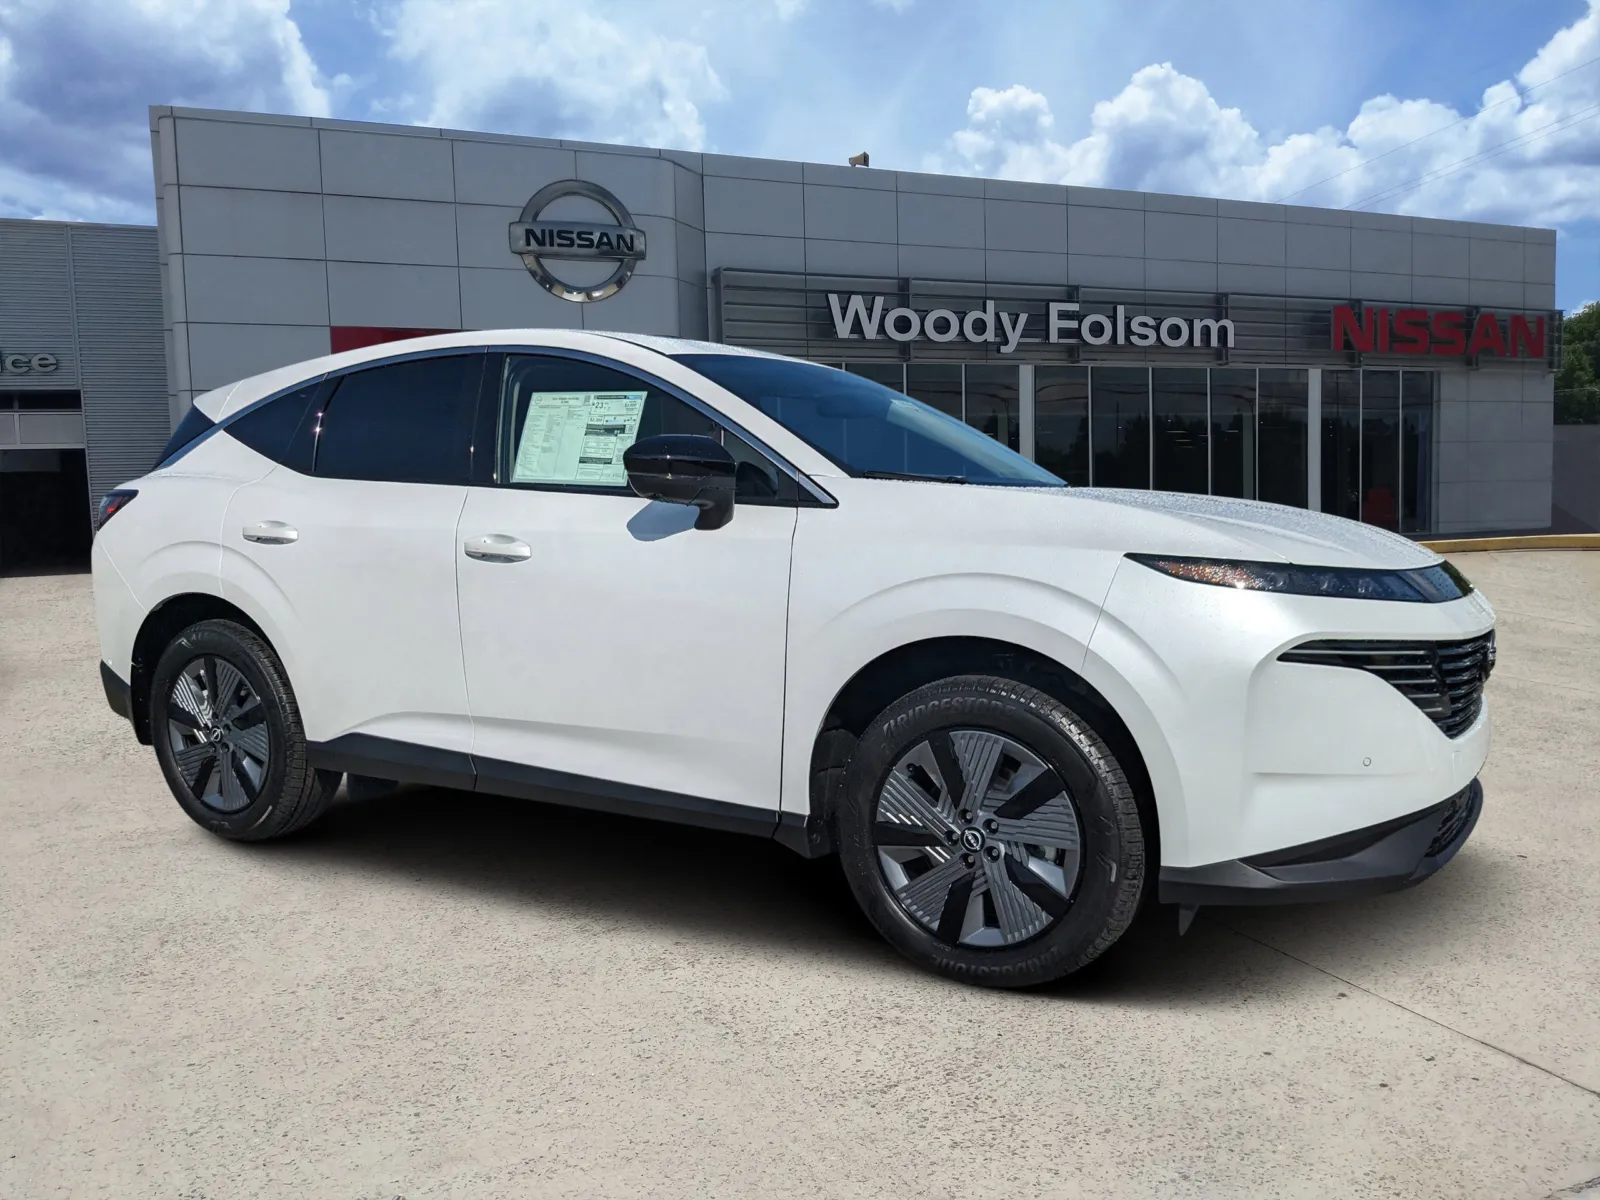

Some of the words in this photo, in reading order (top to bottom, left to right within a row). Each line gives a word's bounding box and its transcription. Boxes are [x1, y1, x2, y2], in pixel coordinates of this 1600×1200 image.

[525, 228, 635, 252] NISSAN
[828, 293, 1028, 353] Woody
[1049, 301, 1235, 348] Folsom
[1333, 305, 1545, 358] NISSAN
